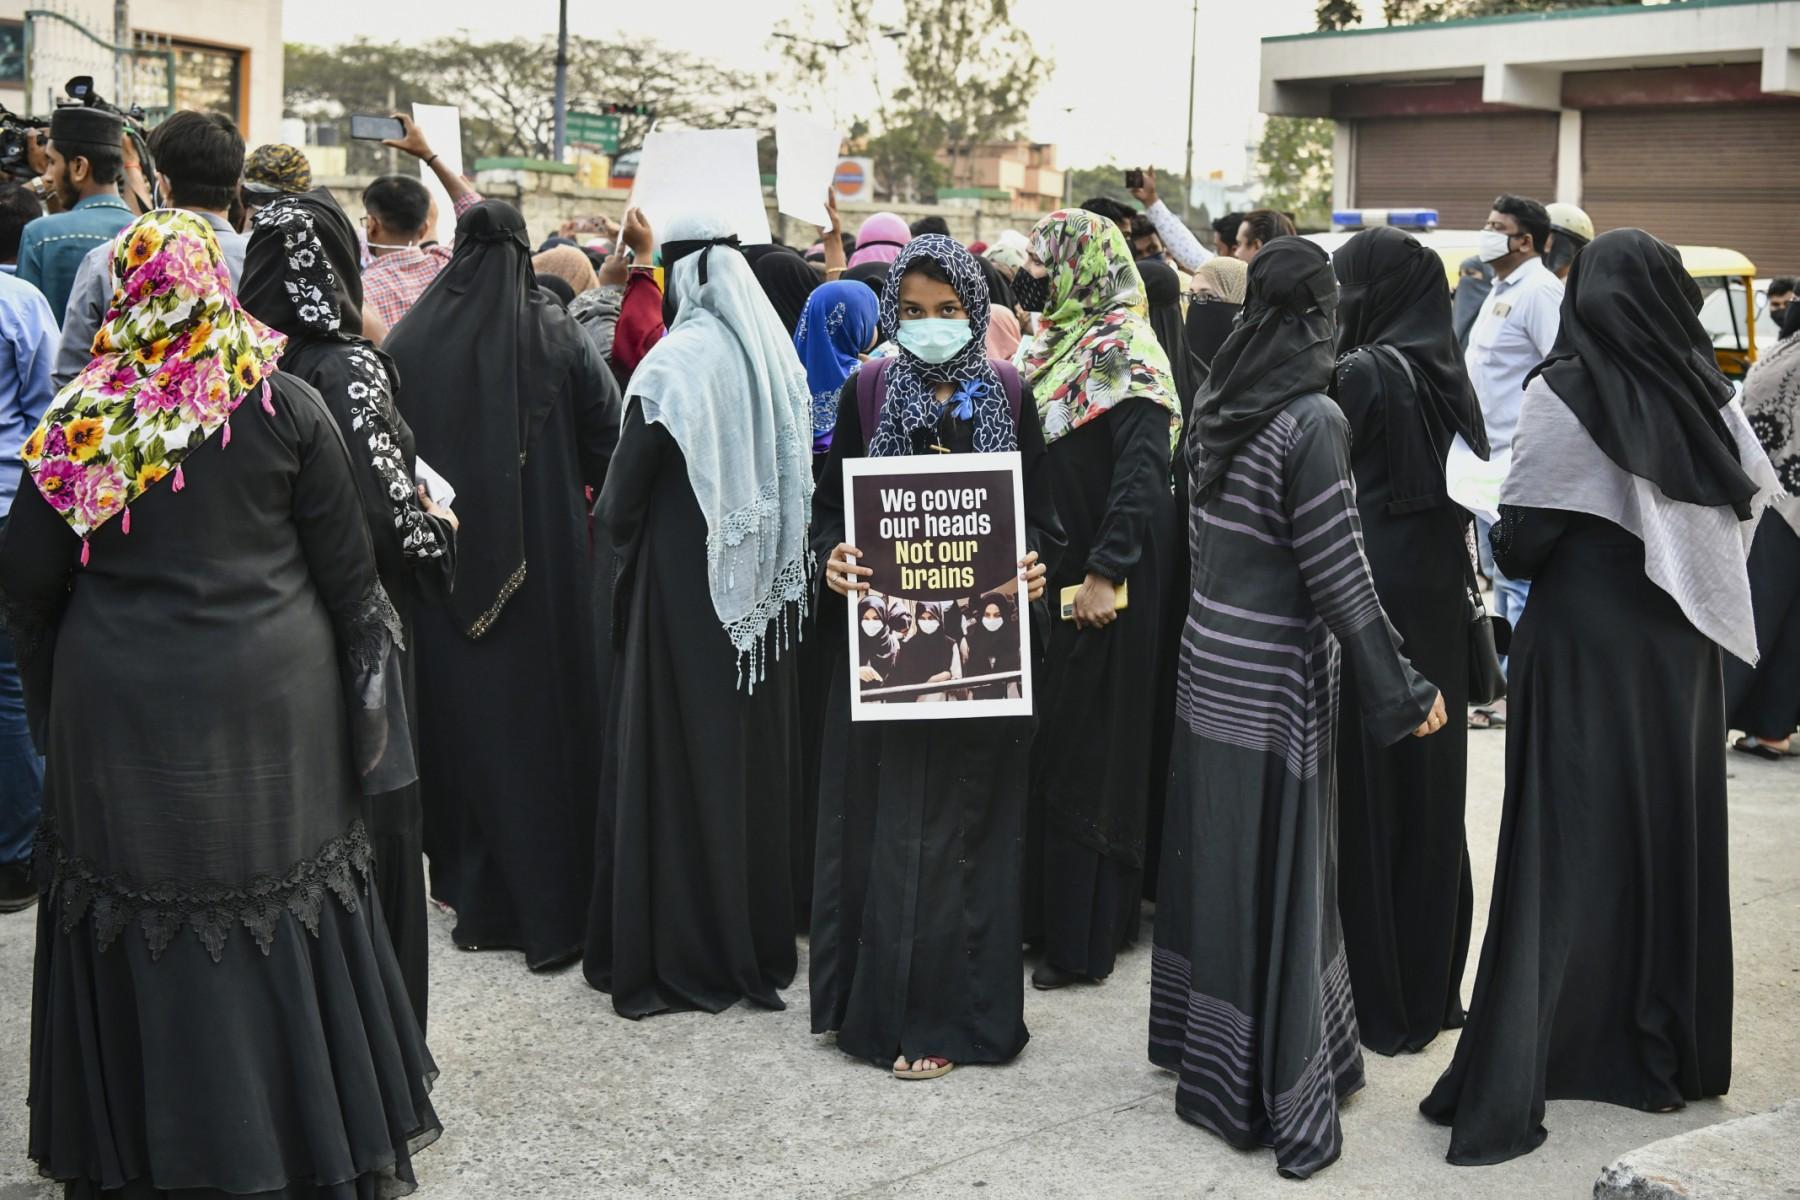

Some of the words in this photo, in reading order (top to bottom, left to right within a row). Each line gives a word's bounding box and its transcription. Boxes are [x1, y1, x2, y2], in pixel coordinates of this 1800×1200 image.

[880, 489, 916, 512] We
[922, 488, 987, 511] cover
[880, 517, 919, 539] our
[925, 512, 991, 537] heads
[896, 540, 934, 564] Not
[939, 541, 977, 562] our
[901, 566, 974, 589] brains
